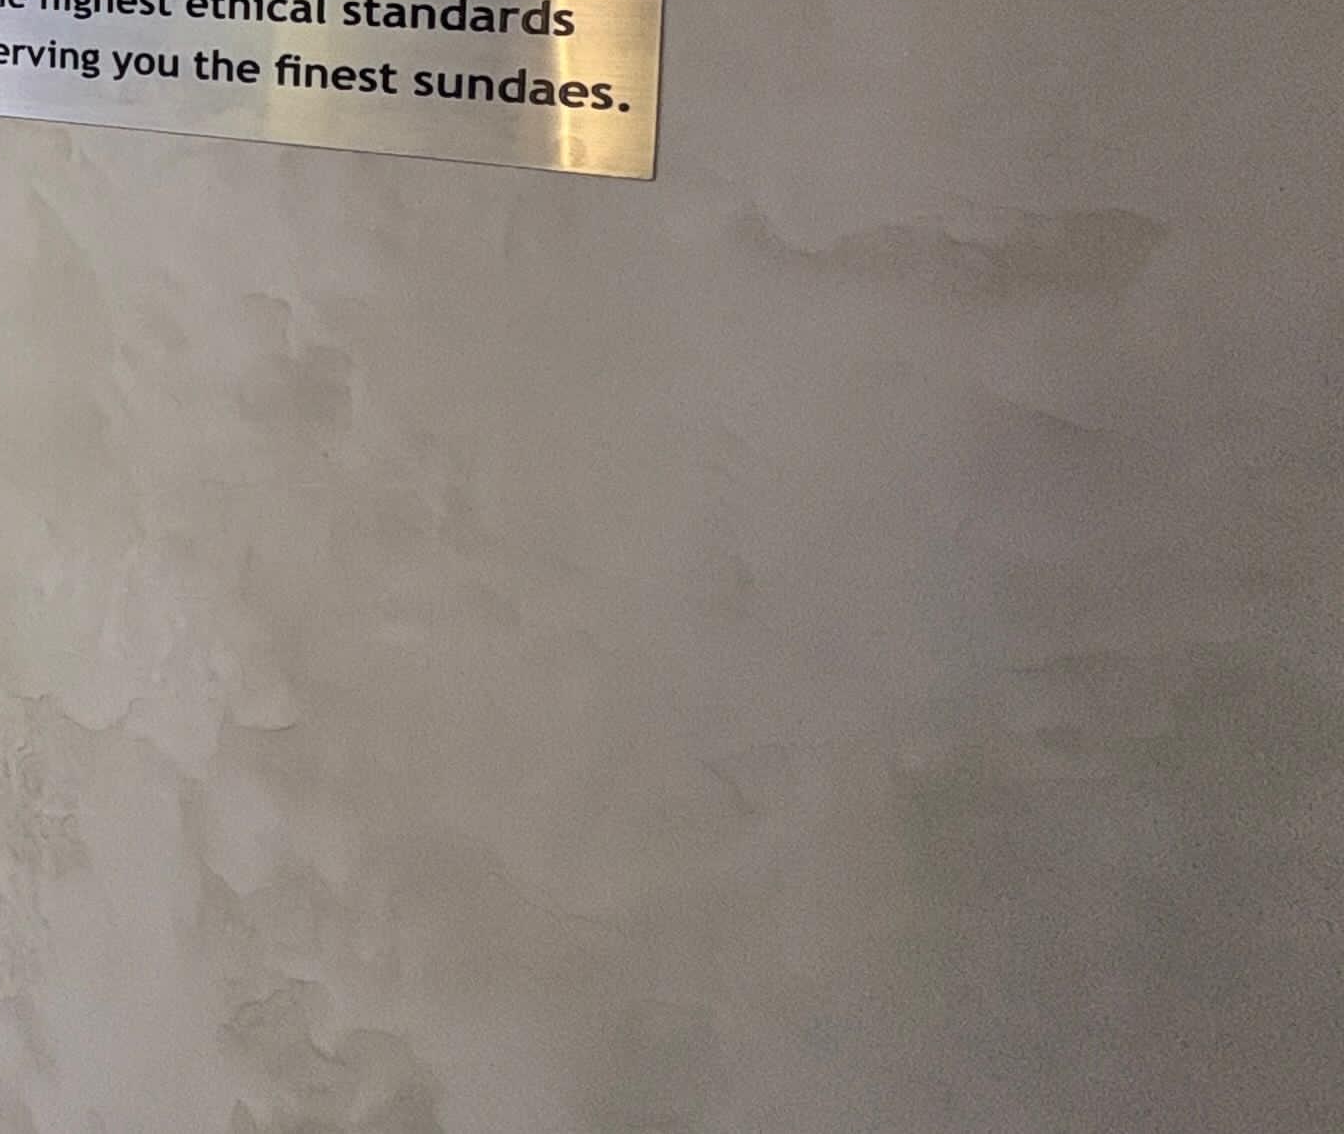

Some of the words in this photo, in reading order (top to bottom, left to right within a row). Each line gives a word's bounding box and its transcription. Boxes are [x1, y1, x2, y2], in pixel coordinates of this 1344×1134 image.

[111, 50, 180, 84] you
[193, 49, 261, 86] the
[275, 54, 398, 96] finest
[413, 68, 632, 114] sundaes.
